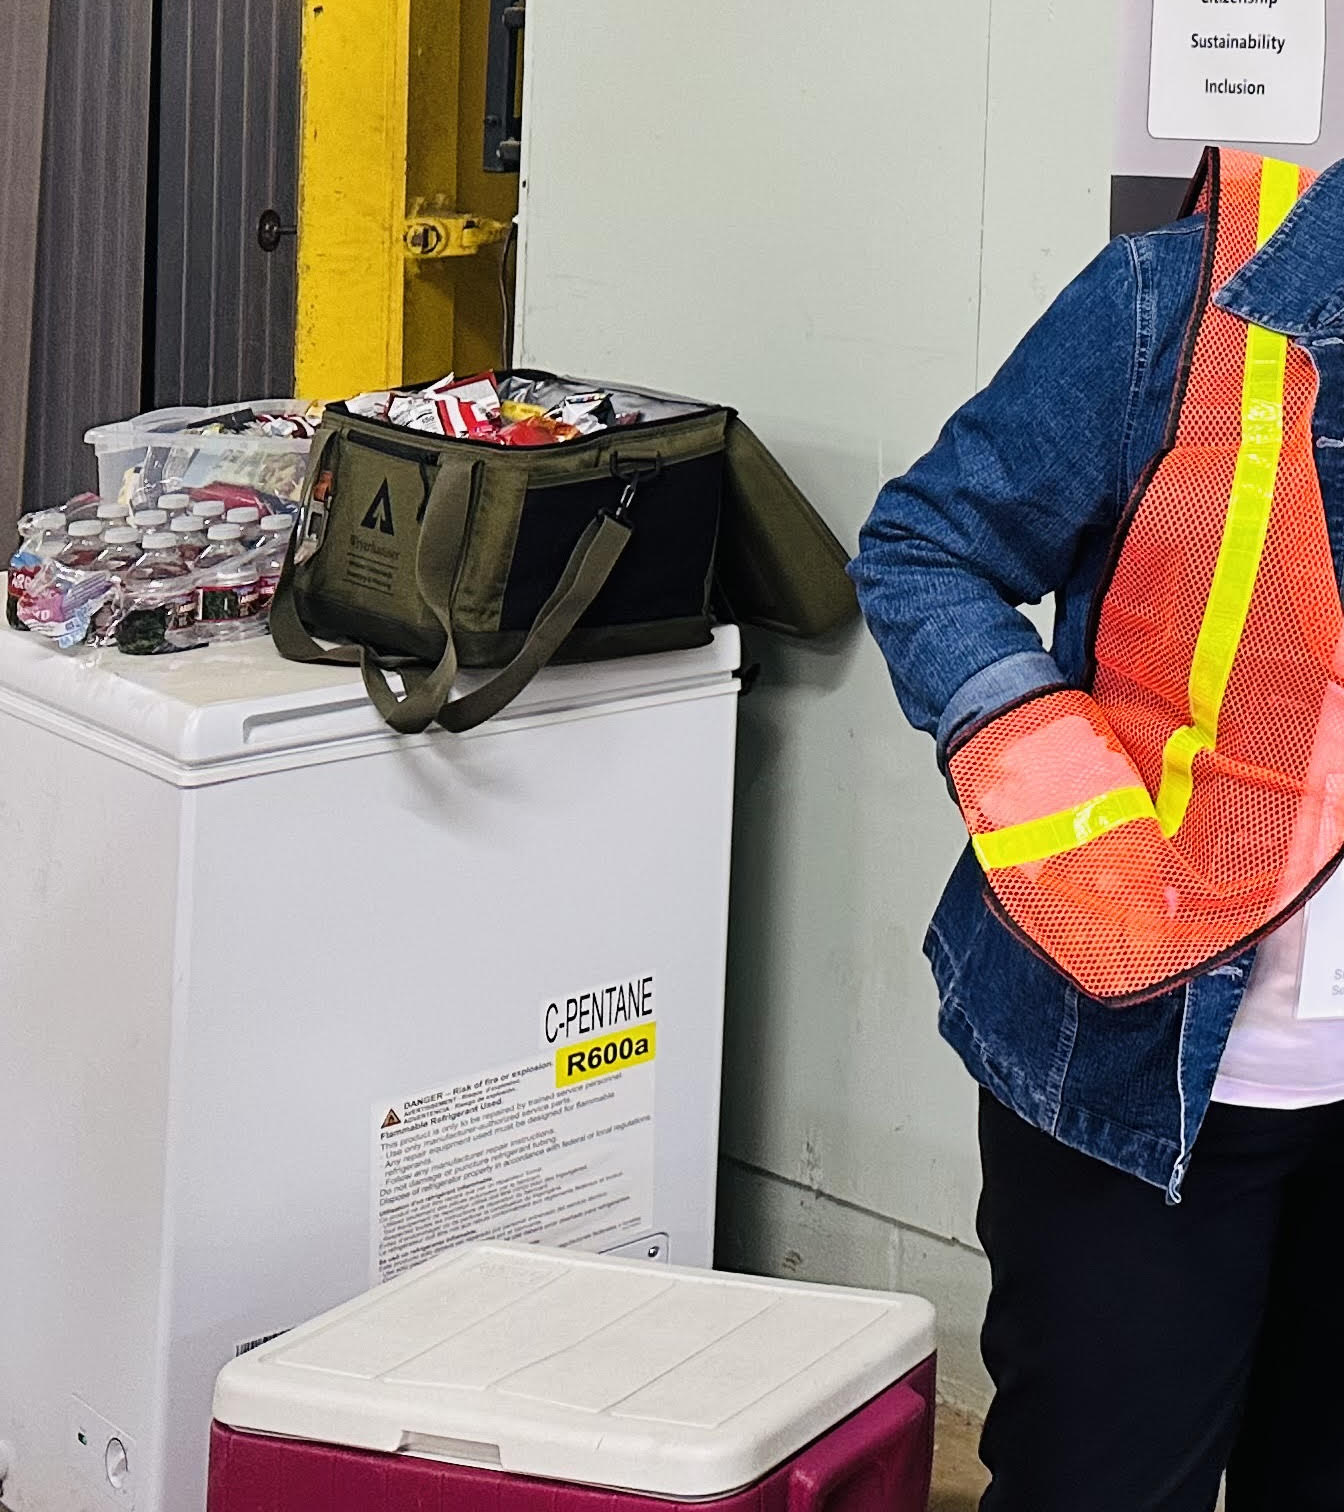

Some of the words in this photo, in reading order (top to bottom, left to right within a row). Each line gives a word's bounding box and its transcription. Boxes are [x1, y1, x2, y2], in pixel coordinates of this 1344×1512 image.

[1190, 32, 1286, 54] Sustainability
[1204, 77, 1265, 96] Inclusion
[545, 976, 653, 1044] C-PENTANE
[567, 1037, 649, 1077] R600a
[404, 1091, 443, 1111] DANGER
[430, 1103, 478, 1126] Refrigerant
[480, 1096, 501, 1111] Used
